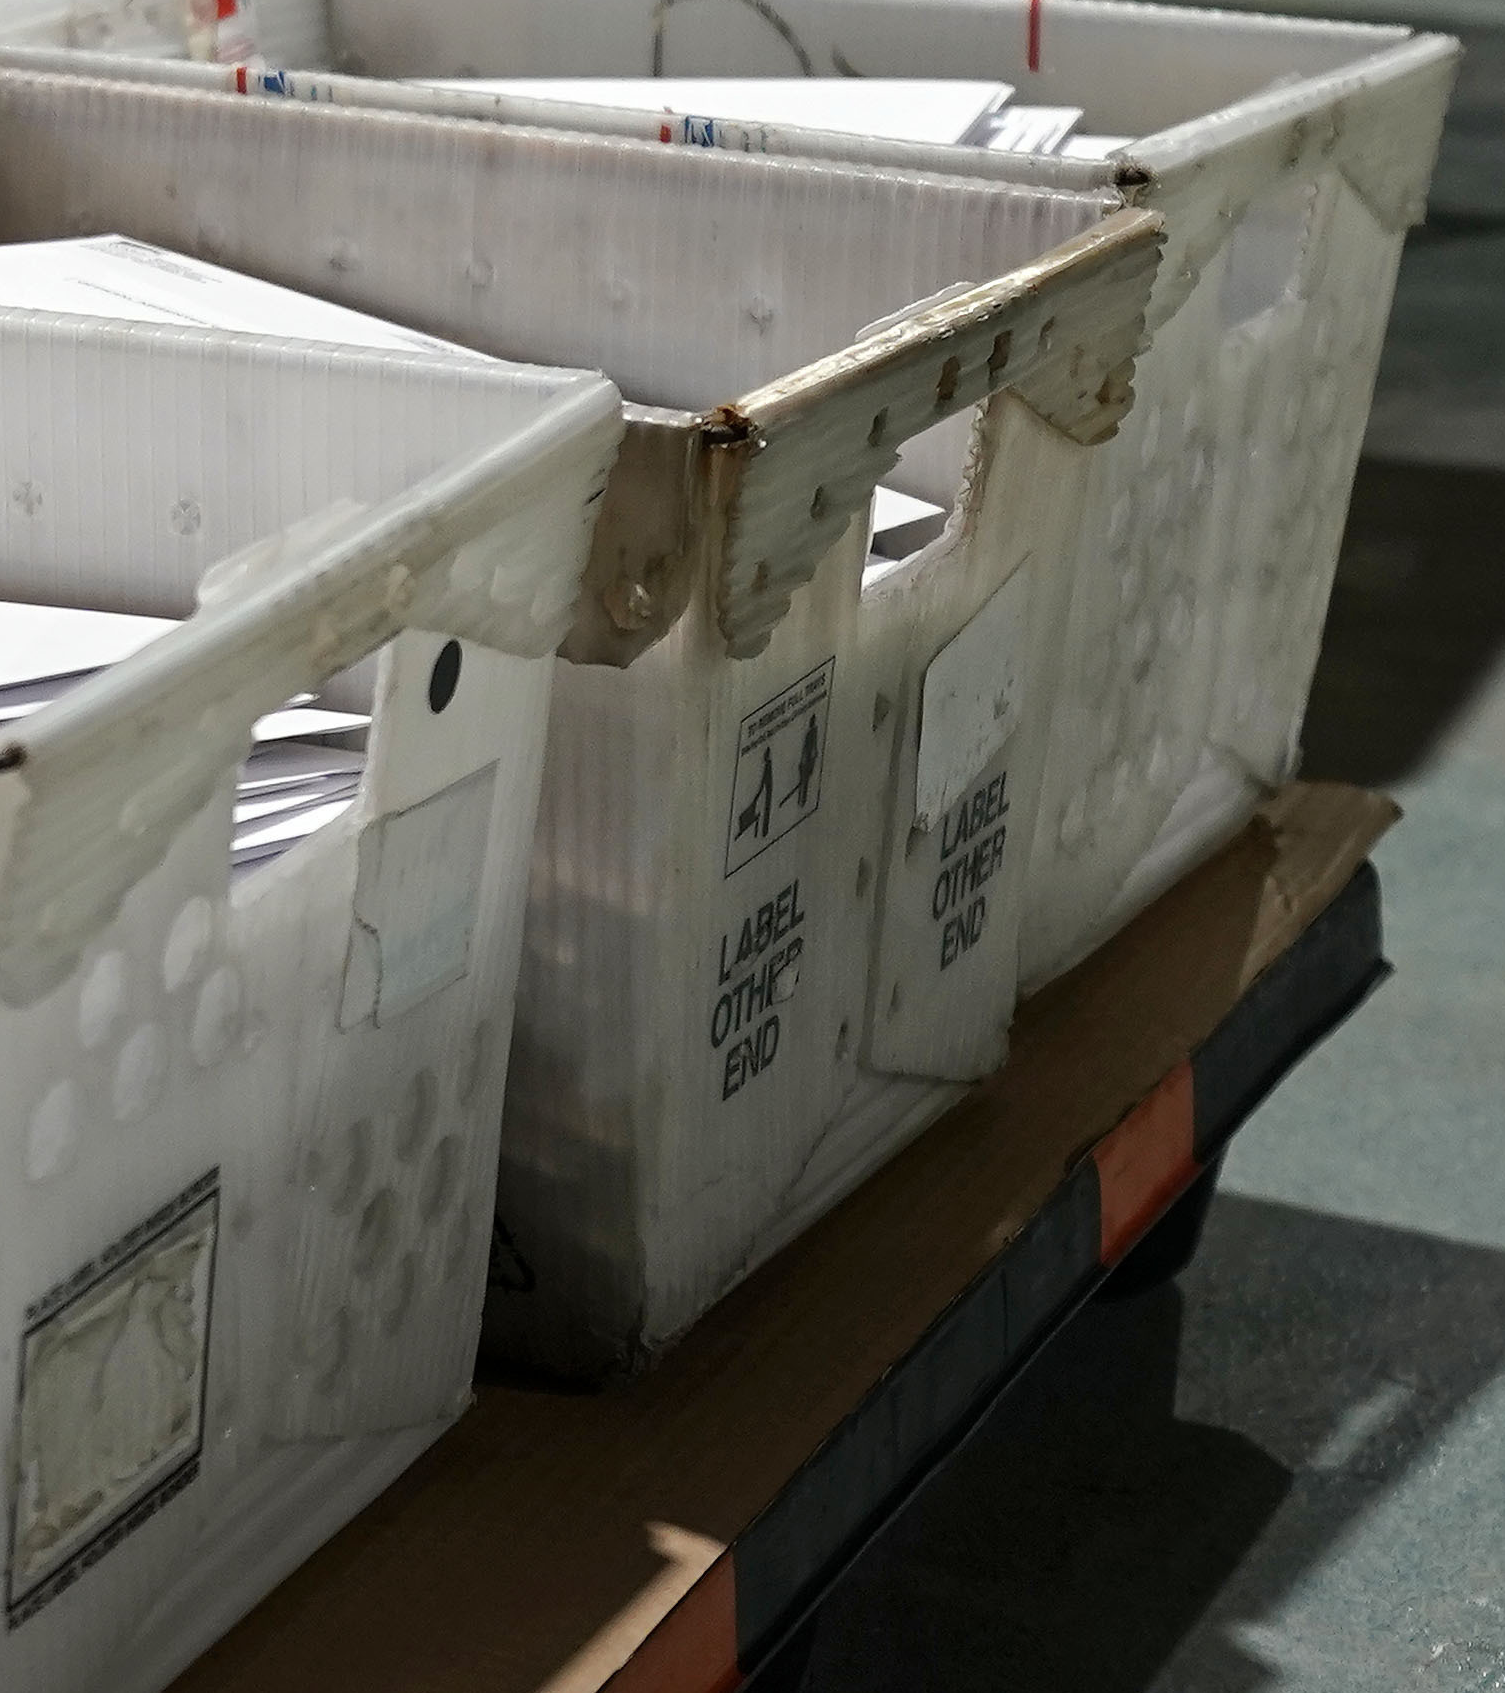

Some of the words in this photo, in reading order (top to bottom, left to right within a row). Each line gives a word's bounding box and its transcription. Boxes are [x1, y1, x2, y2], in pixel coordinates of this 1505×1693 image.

[940, 771, 1011, 861] LABEL
[932, 824, 1007, 922] OTHER
[718, 879, 805, 987] LABEL
[940, 896, 986, 971] END
[710, 936, 804, 1050] OTHER
[722, 1014, 779, 1102] END
